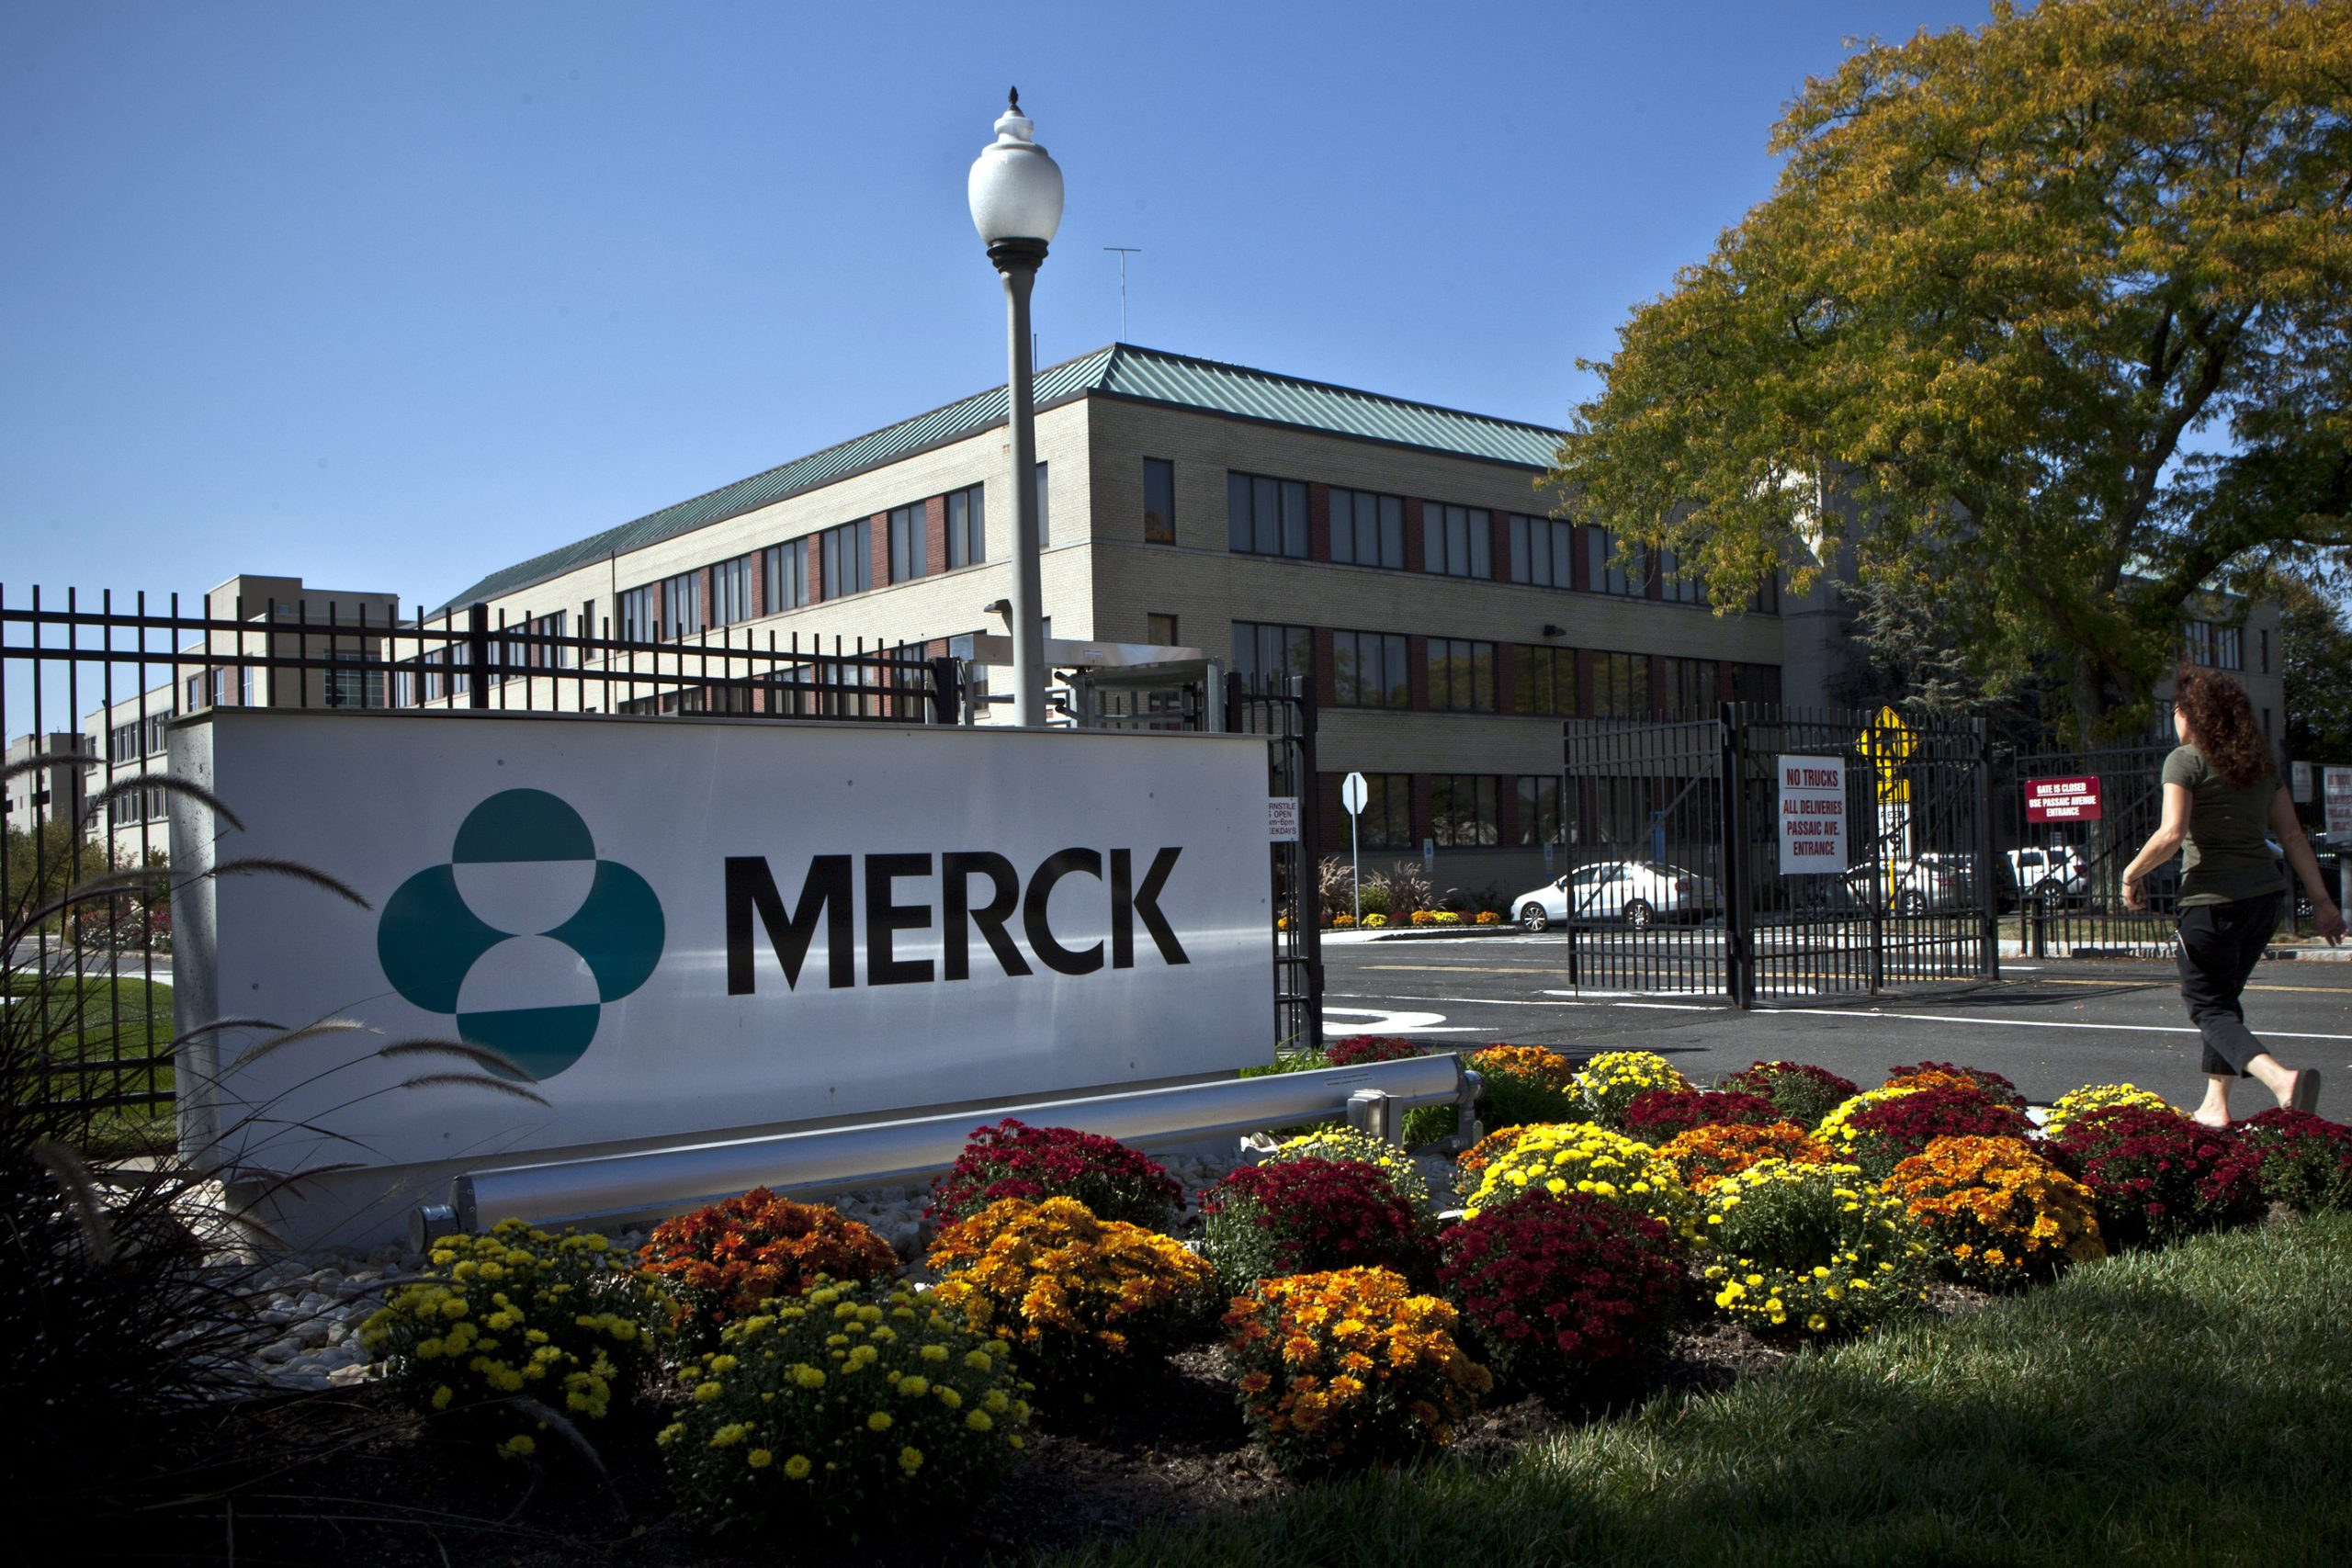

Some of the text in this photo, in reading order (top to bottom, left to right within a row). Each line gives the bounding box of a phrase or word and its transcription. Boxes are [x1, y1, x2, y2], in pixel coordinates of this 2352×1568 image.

[1787, 768, 1838, 787] NO TRUCKS
[2037, 783, 2086, 794] GATE IS CLOSED
[1783, 799, 1842, 815] ALL DELIVERIES
[2029, 795, 2097, 807] USE PASSAIC AVENUE
[2046, 807, 2079, 817] ENTRANCE
[1269, 818, 1295, 827] m-6pm
[1787, 820, 1840, 836] PASSAIC AVE.
[1793, 840, 1835, 856] ENTRANCE
[725, 847, 1191, 996] MERCK
